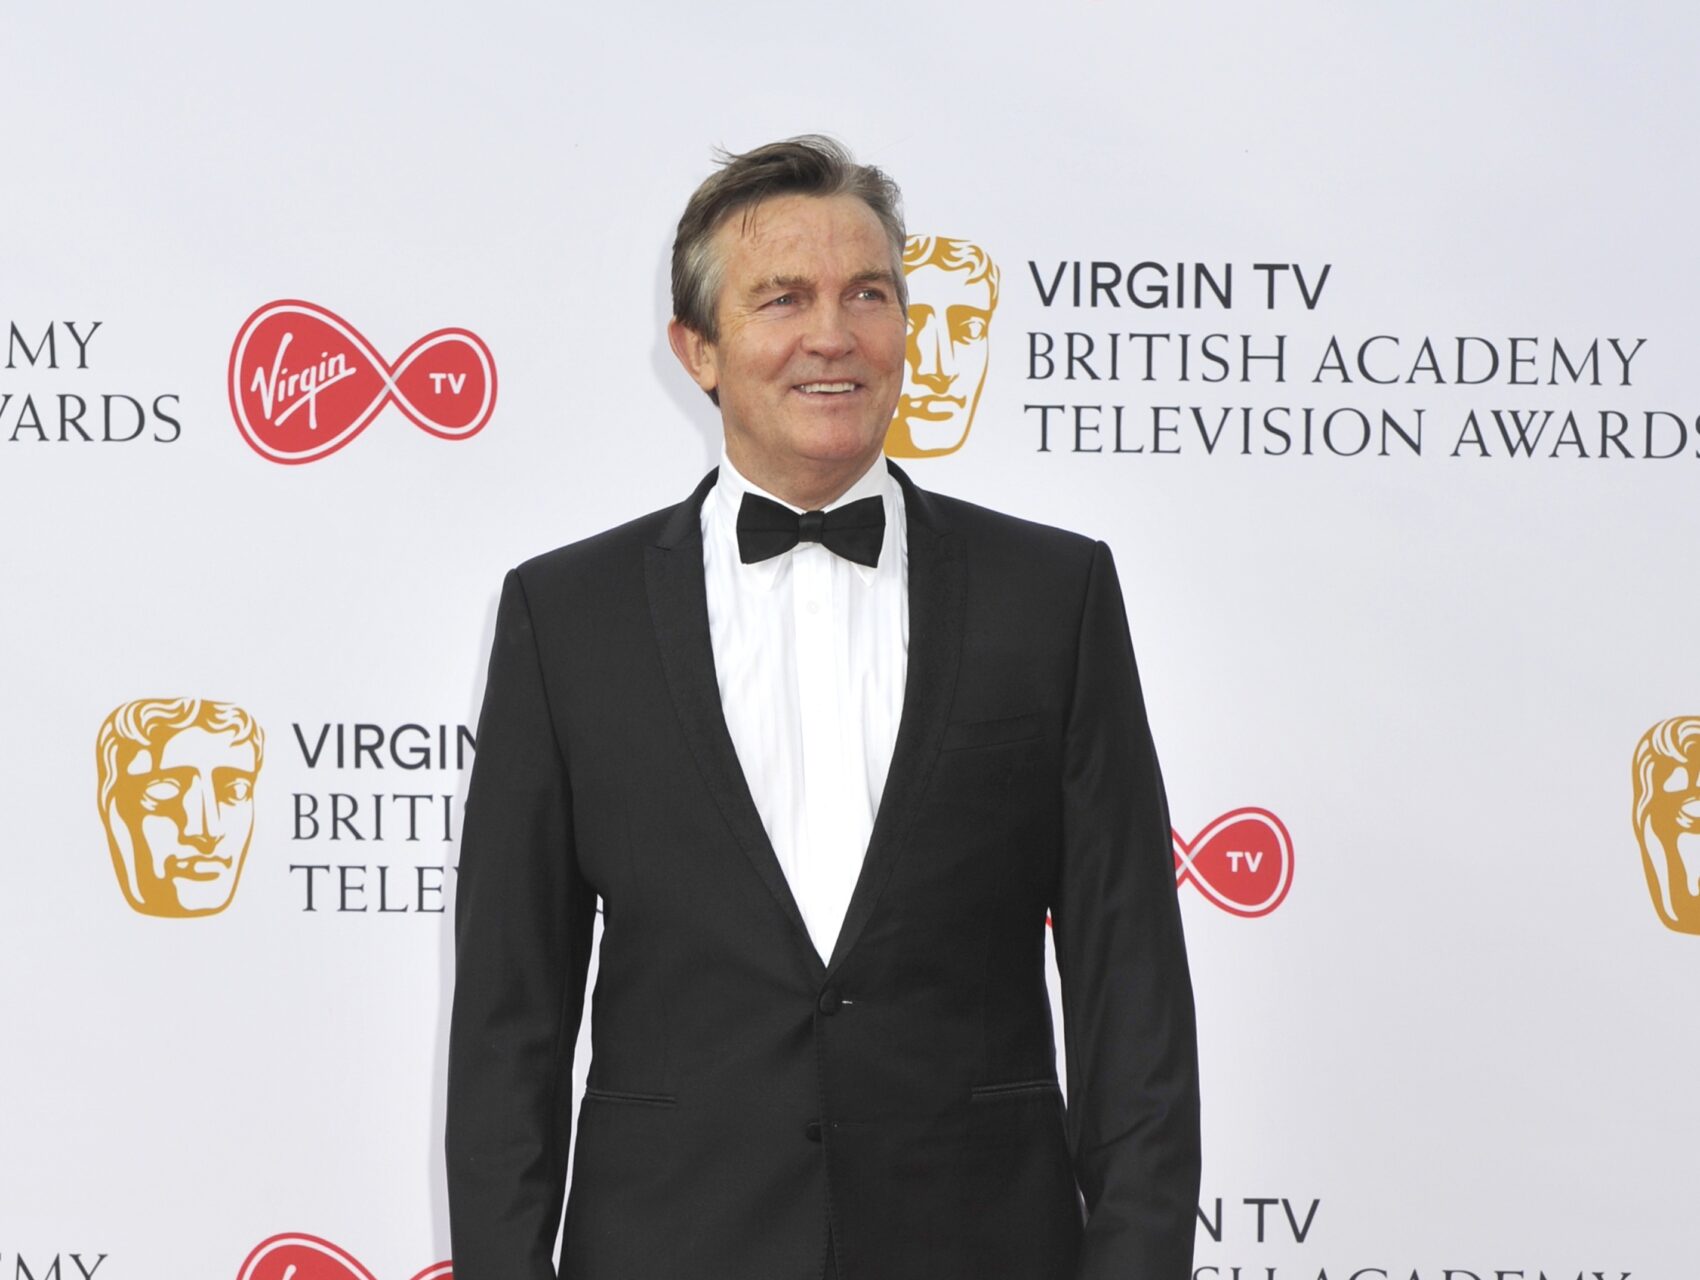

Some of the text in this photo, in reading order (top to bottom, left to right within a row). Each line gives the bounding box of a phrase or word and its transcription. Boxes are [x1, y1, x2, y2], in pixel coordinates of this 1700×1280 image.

[1028, 260, 1332, 310] VIRGIN TV
[250, 332, 466, 430] Virgin TV
[1027, 332, 1647, 386] BRITISH ACADEMY
[0, 393, 181, 443] ARDS
[1024, 404, 1700, 459] TELEVISION AWARD
[293, 793, 467, 842] BRITI
[1226, 851, 1263, 873] TV
[289, 864, 458, 913] TELE
[1243, 1198, 1321, 1243] TV
